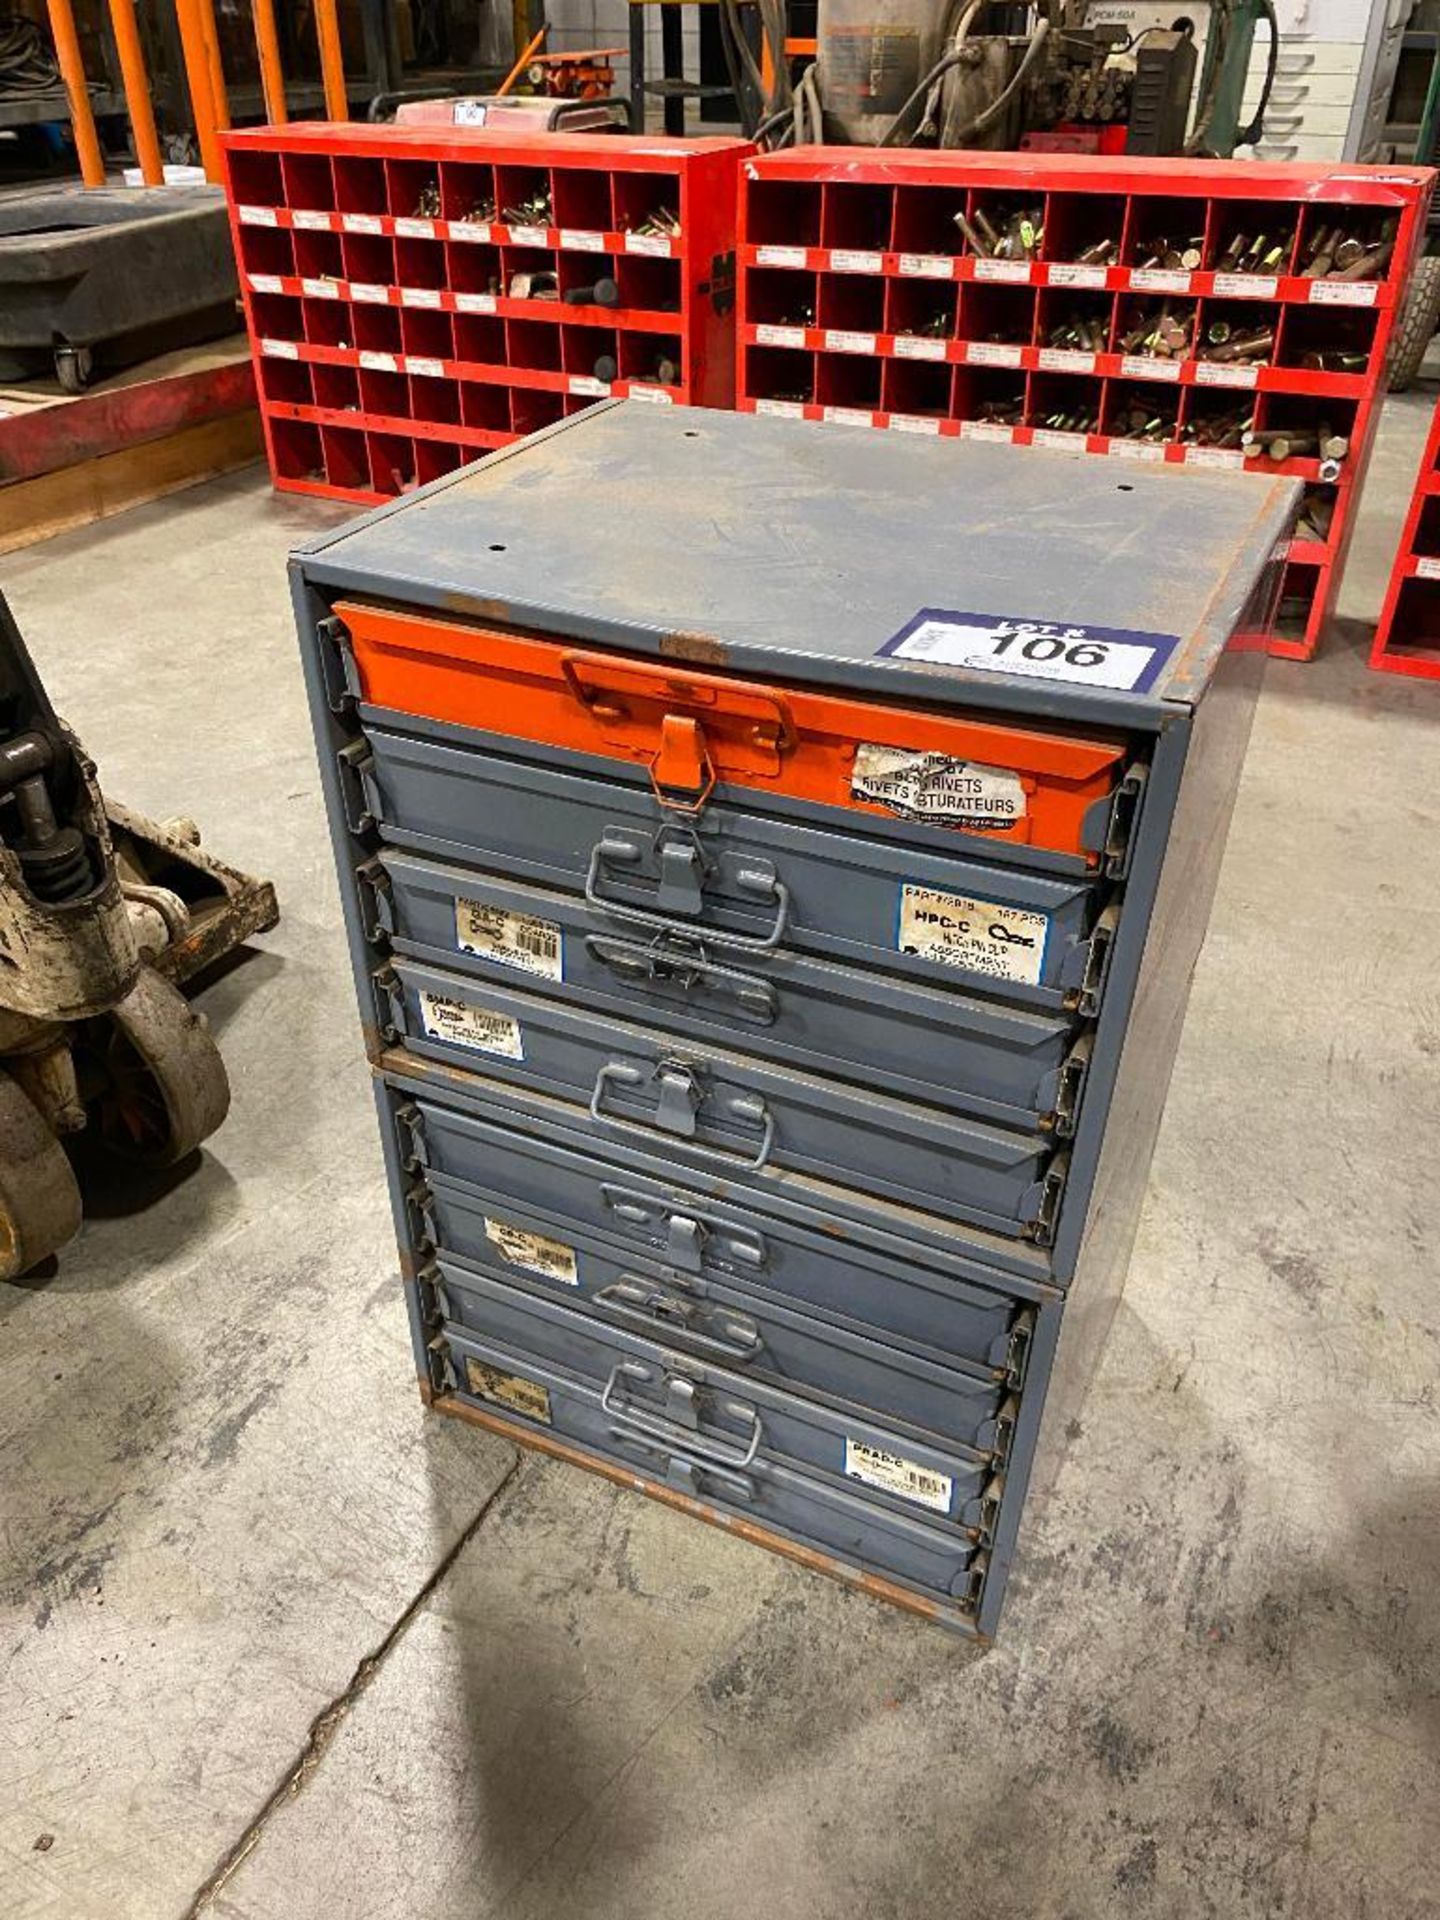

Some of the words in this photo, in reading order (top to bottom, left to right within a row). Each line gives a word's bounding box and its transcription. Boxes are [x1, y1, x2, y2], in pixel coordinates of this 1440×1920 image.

[997, 621, 1059, 635] LOT
[990, 632, 1110, 667] 106
[931, 776, 983, 793] RIVETS
[913, 788, 1015, 814] BTURATEURS
[914, 909, 971, 933] HPC-C
